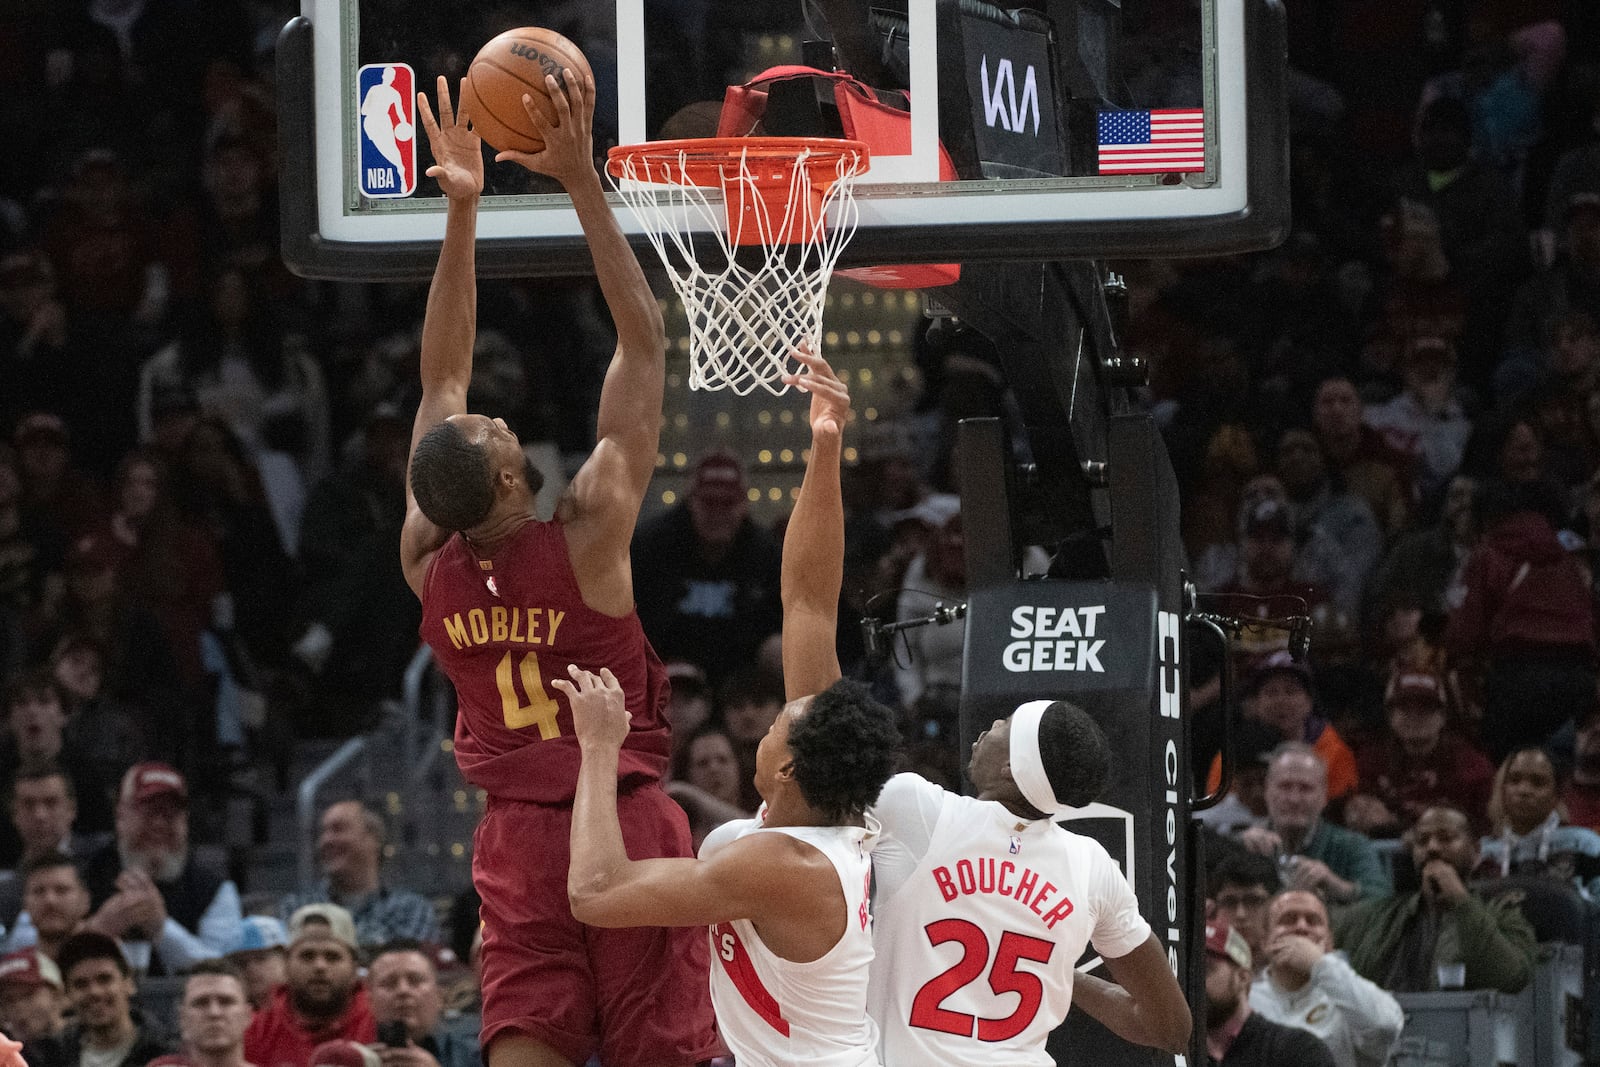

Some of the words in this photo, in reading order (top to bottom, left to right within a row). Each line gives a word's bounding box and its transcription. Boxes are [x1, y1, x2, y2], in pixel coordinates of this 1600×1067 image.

[367, 167, 395, 189] NBA
[443, 606, 566, 650] MOBLEY
[1010, 605, 1106, 639] SEAT
[1002, 640, 1107, 673] GEEK
[495, 650, 562, 741] 4
[931, 857, 1074, 930] BOUCHER
[909, 918, 1056, 1043] 25
